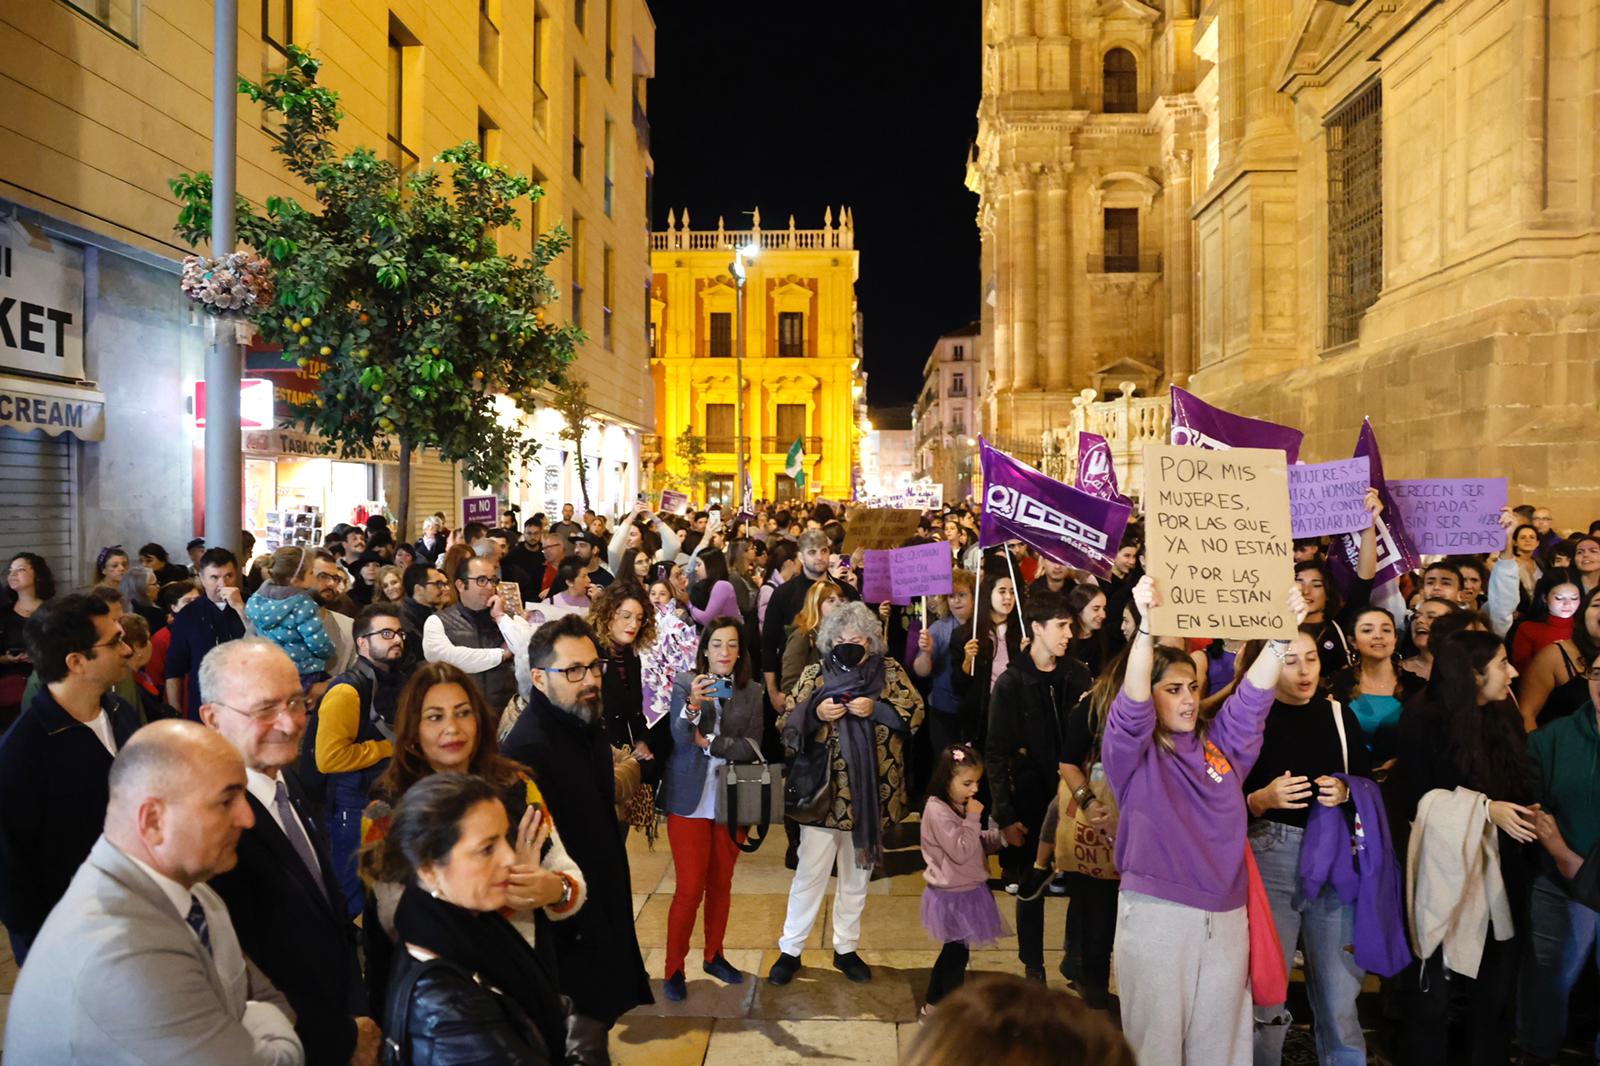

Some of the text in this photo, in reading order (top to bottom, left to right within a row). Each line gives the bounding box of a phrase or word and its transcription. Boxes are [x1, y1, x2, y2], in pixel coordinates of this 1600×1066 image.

[0, 395, 84, 428] CREAM
[1160, 456, 1256, 482] POR MIS
[1462, 484, 1485, 497] SER
[479, 500, 490, 511] NO
[1160, 490, 1250, 511] MUJERES,
[1415, 500, 1479, 513] AMADAS
[1158, 513, 1191, 531] POR
[1196, 517, 1227, 531] LAS
[1406, 516, 1427, 529] SIN
[1437, 515, 1462, 529] SER
[1164, 534, 1288, 557] YA NO ESTÁN
[1165, 562, 1260, 584] Y POR LAS
[1170, 585, 1271, 605] QUE ESTÁN
[1177, 615, 1201, 629] EN
[1074, 845, 1098, 864] ON
